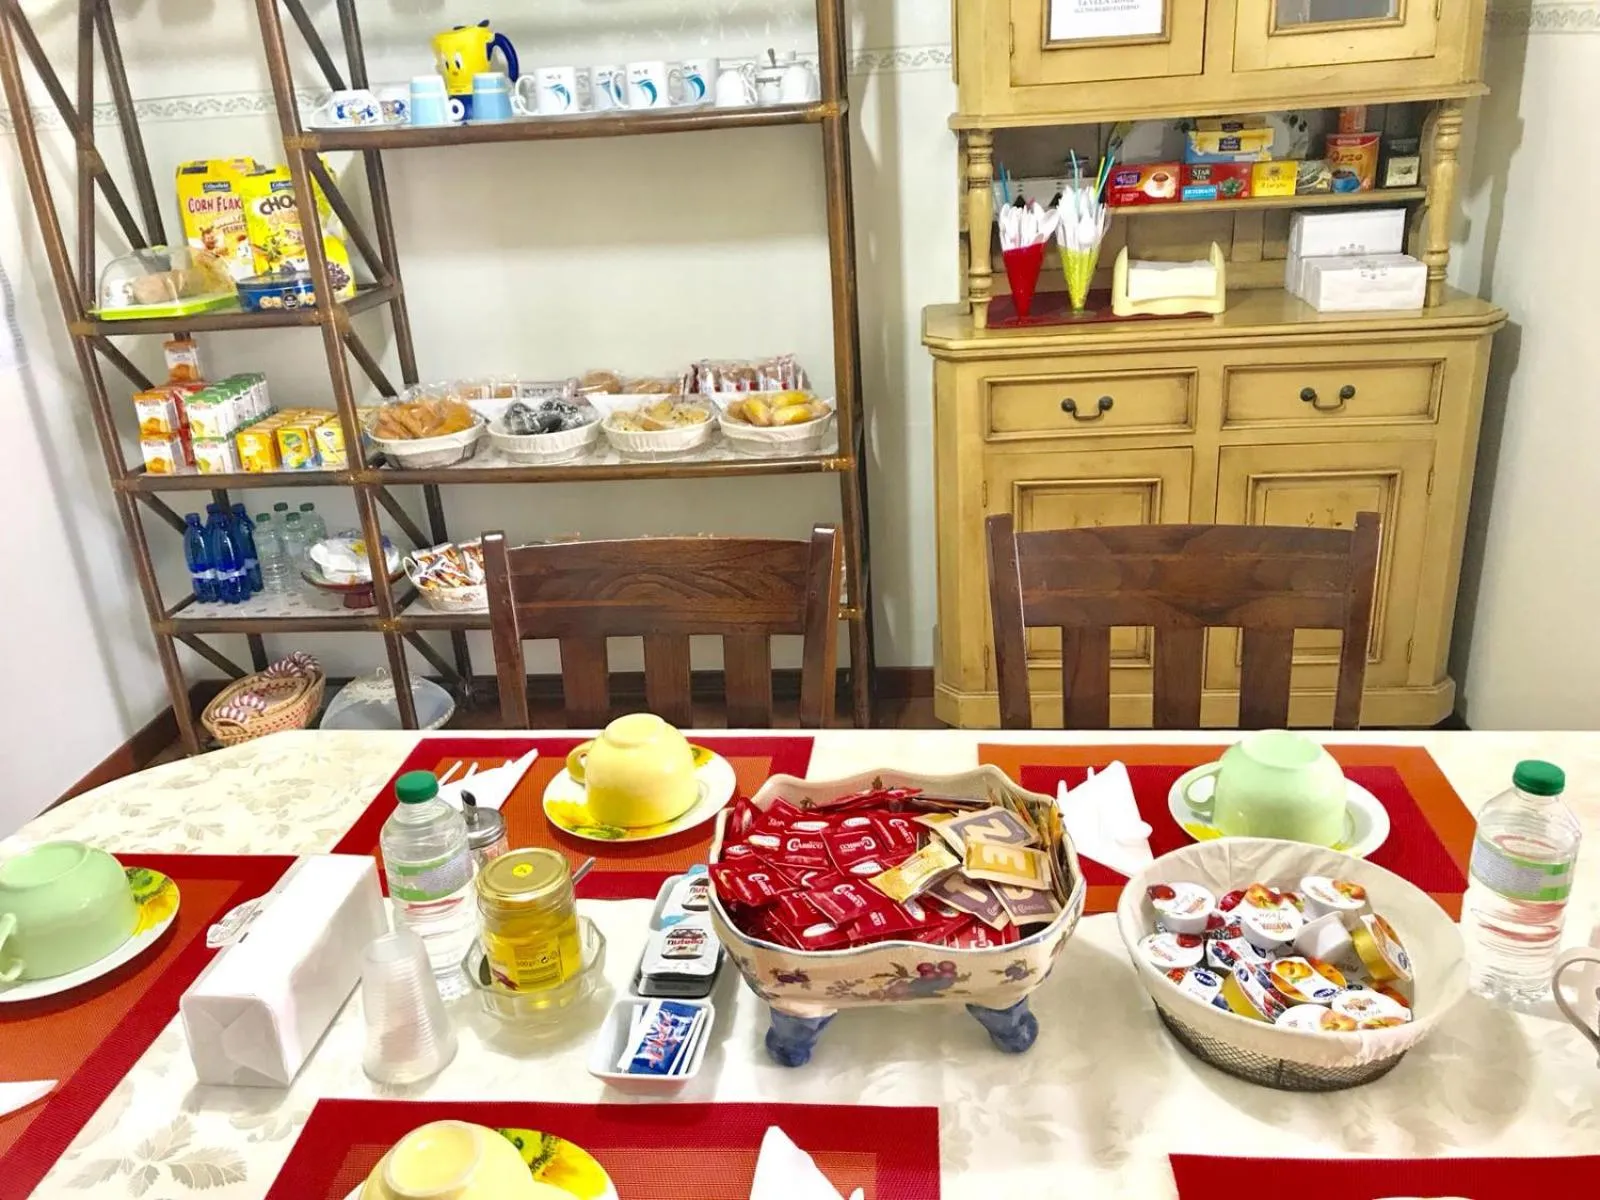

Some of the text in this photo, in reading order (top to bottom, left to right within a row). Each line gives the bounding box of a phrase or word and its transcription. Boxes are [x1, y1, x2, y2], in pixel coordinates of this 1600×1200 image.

[188, 197, 241, 213] CORN FLAK
[259, 195, 293, 215] CHO
